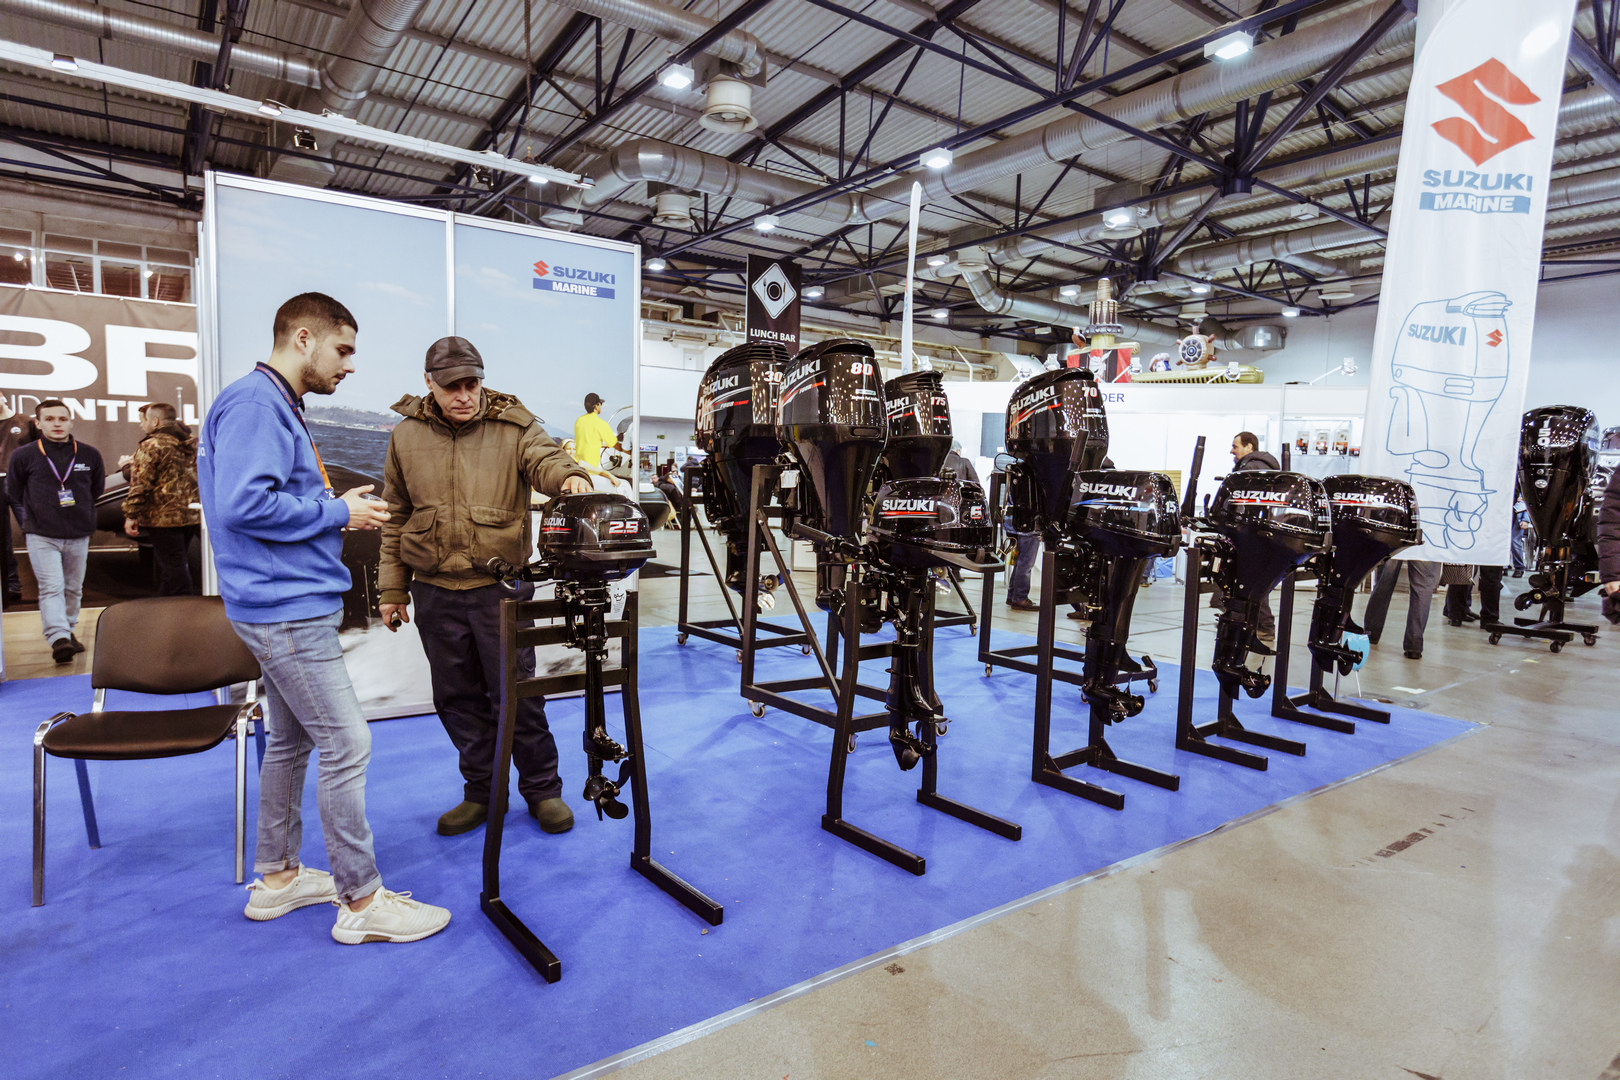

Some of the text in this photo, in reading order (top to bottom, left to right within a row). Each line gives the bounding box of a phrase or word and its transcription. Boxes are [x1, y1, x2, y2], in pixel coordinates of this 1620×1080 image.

[1422, 169, 1533, 192] SUZUKI
[1433, 192, 1515, 212] MARINE
[552, 265, 615, 285] SUZUKI
[552, 281, 597, 296] MARINE
[750, 328, 796, 343] LUNCH BAR
[1407, 323, 1467, 346] SUZUKI
[850, 362, 874, 376] 80
[1082, 386, 1098, 398] 70
[930, 396, 946, 406] 175
[1010, 385, 1055, 415] SUZUKI
[1079, 482, 1138, 499] SUZUKI
[1232, 490, 1287, 502] SUZUKI
[1333, 492, 1385, 504] SUZUKI
[882, 499, 935, 512] SUZUKI
[543, 517, 566, 527] SUZUKI
